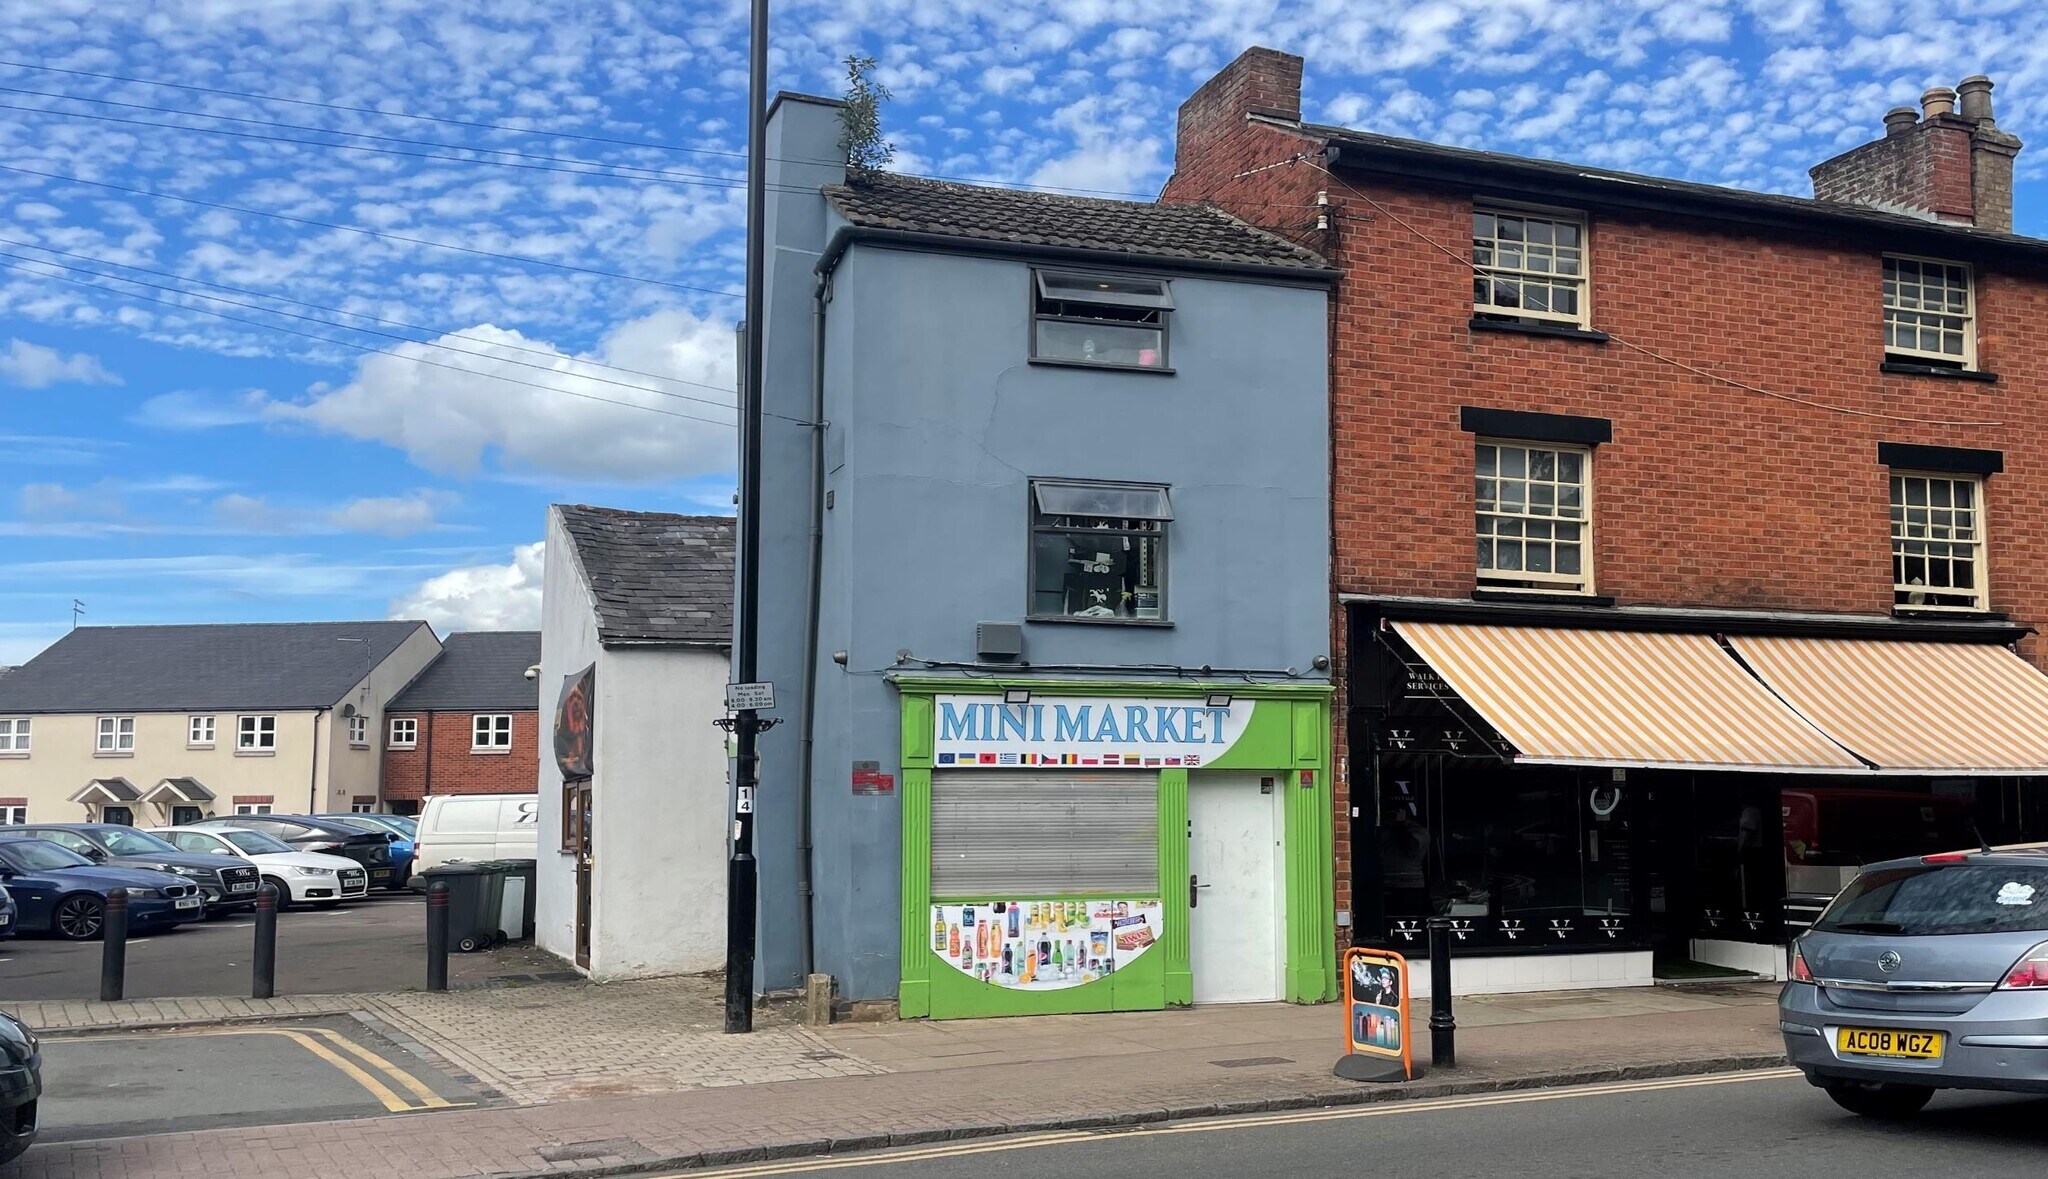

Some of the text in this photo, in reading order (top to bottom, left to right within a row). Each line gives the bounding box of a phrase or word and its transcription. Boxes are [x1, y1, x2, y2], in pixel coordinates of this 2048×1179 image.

[1408, 672, 1436, 681] WALK
[1406, 682, 1449, 691] SERVICES
[939, 702, 1230, 744] MINI MARKET
[1121, 930, 1148, 944] TWIX
[1847, 1031, 1933, 1053] AC08 WGZ
